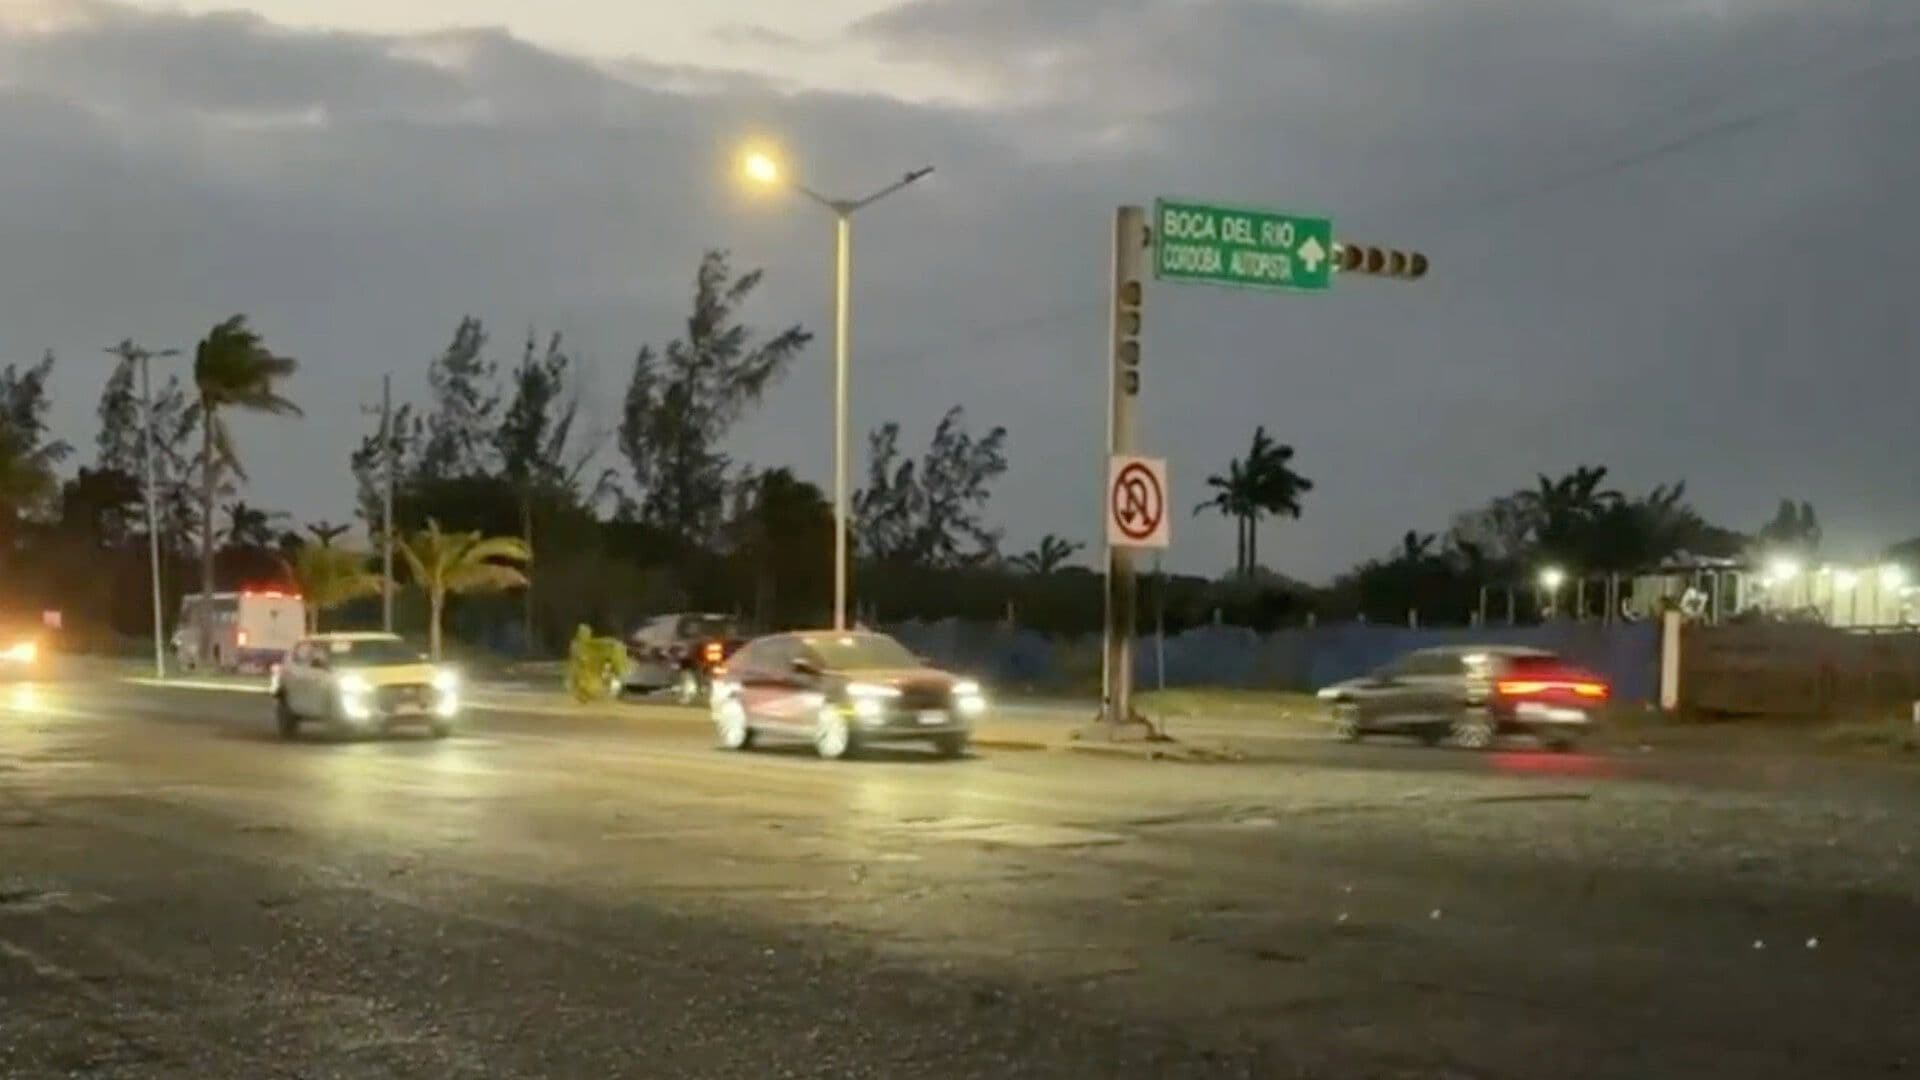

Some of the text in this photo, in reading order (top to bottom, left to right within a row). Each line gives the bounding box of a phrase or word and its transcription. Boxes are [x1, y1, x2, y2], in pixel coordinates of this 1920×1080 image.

[1164, 210, 1295, 249] BOCA DEL RIO
